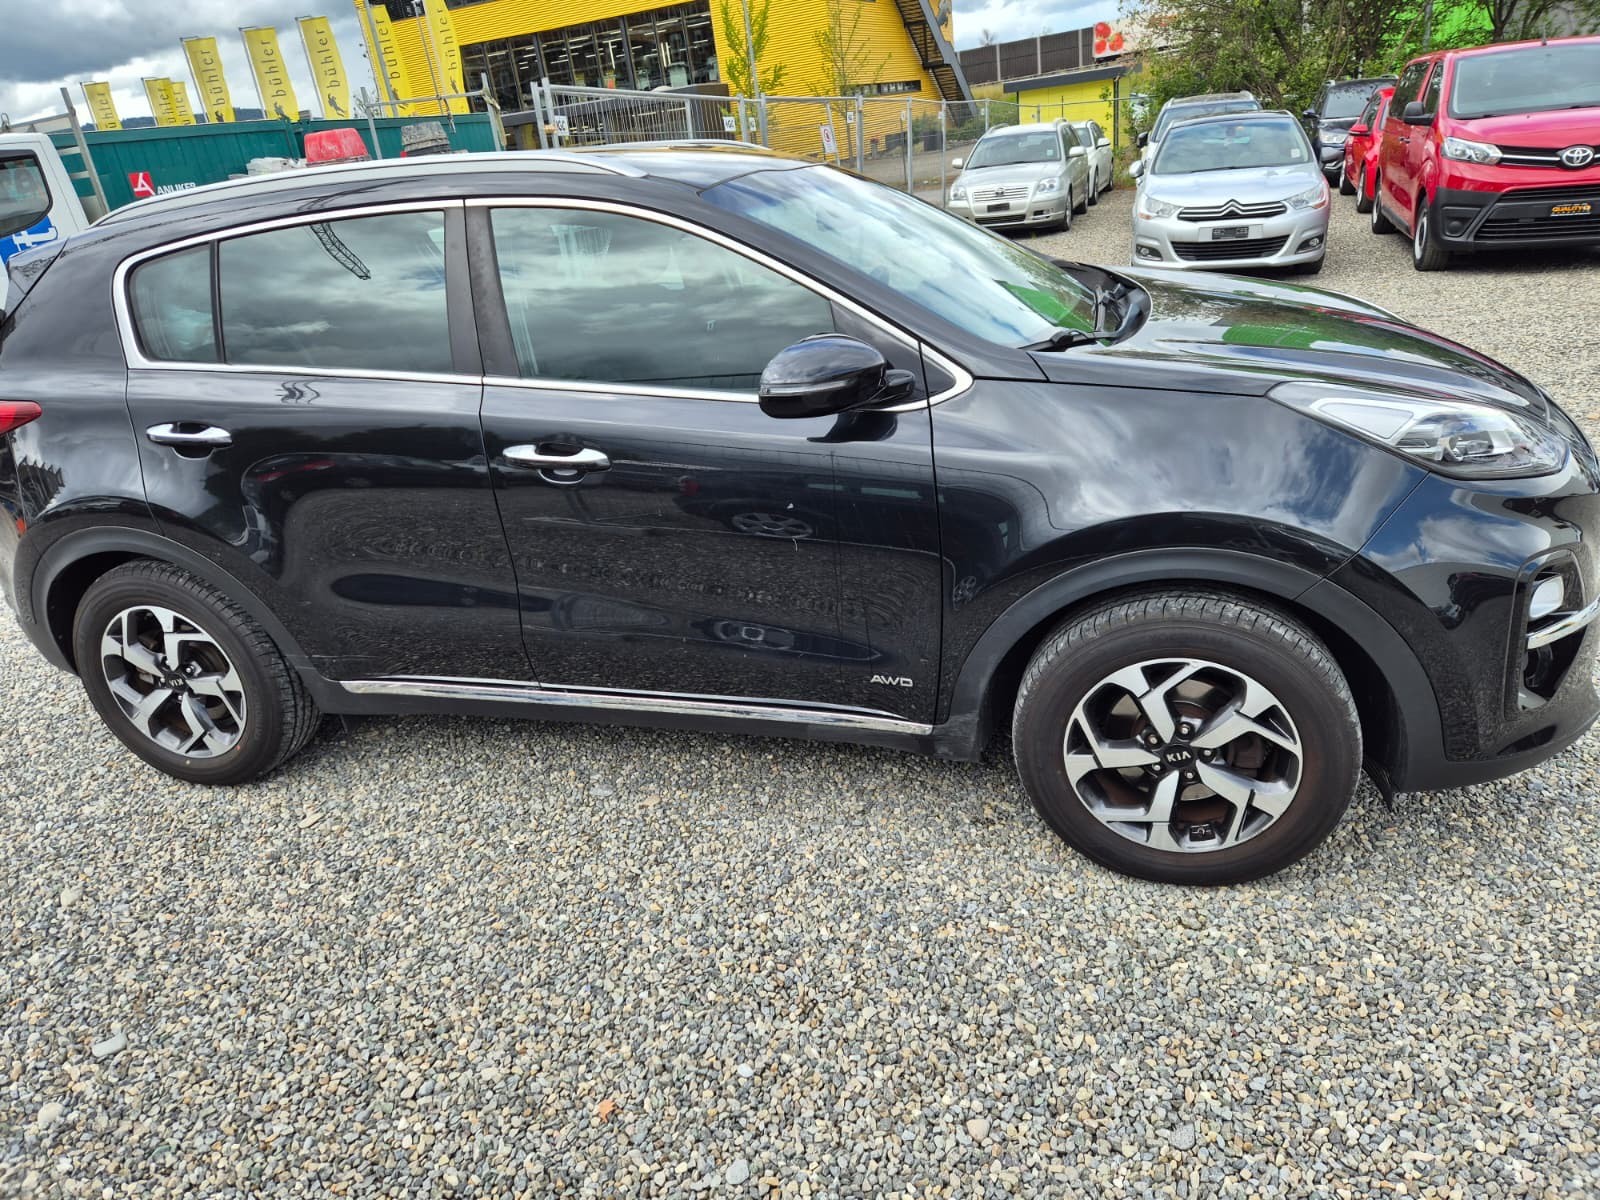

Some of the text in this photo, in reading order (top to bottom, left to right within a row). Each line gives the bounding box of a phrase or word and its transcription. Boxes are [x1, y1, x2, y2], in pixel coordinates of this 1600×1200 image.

[316, 29, 341, 89] bühler
[437, 8, 457, 71] bühler
[200, 49, 226, 106] bühler
[261, 39, 287, 98] bühler
[97, 92, 118, 129] ühler
[870, 674, 914, 687] AWD
[1166, 750, 1191, 763] KIA
